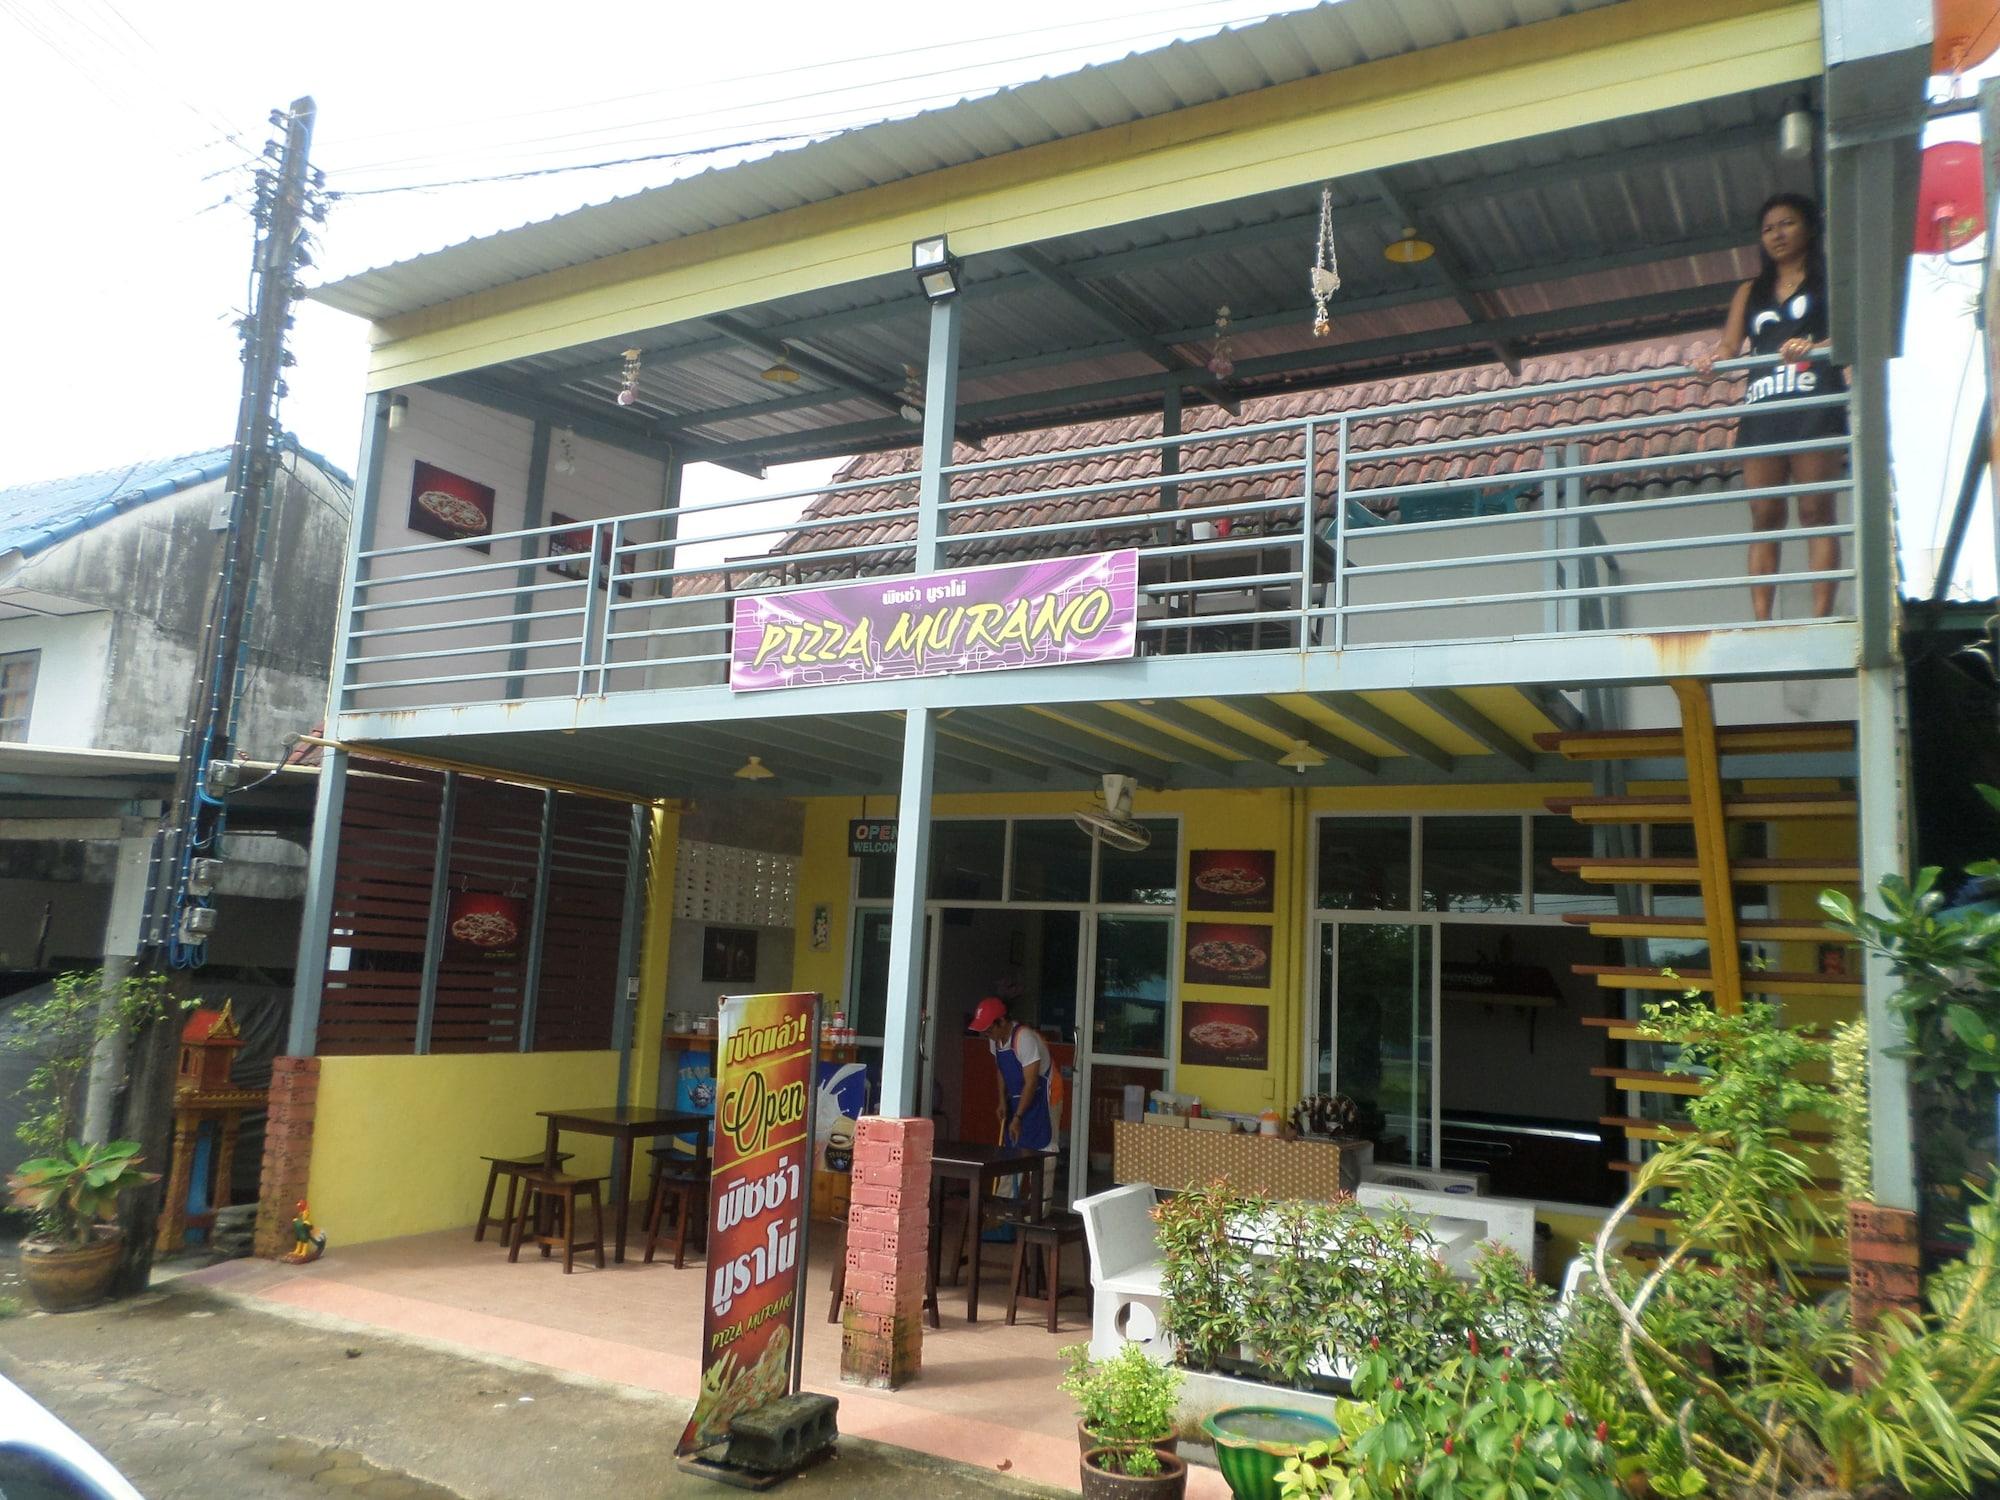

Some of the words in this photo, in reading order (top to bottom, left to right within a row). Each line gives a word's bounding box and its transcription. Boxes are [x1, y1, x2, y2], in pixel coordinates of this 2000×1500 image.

[753, 616, 872, 669] PIZZA
[884, 588, 1111, 667] MURANO
[853, 842, 897, 853] WELCOM
[722, 1070, 804, 1155] Open
[712, 1217, 798, 1317] มูราโน่
[711, 1321, 743, 1352] PIZZA
[746, 1290, 793, 1333] MURANO
